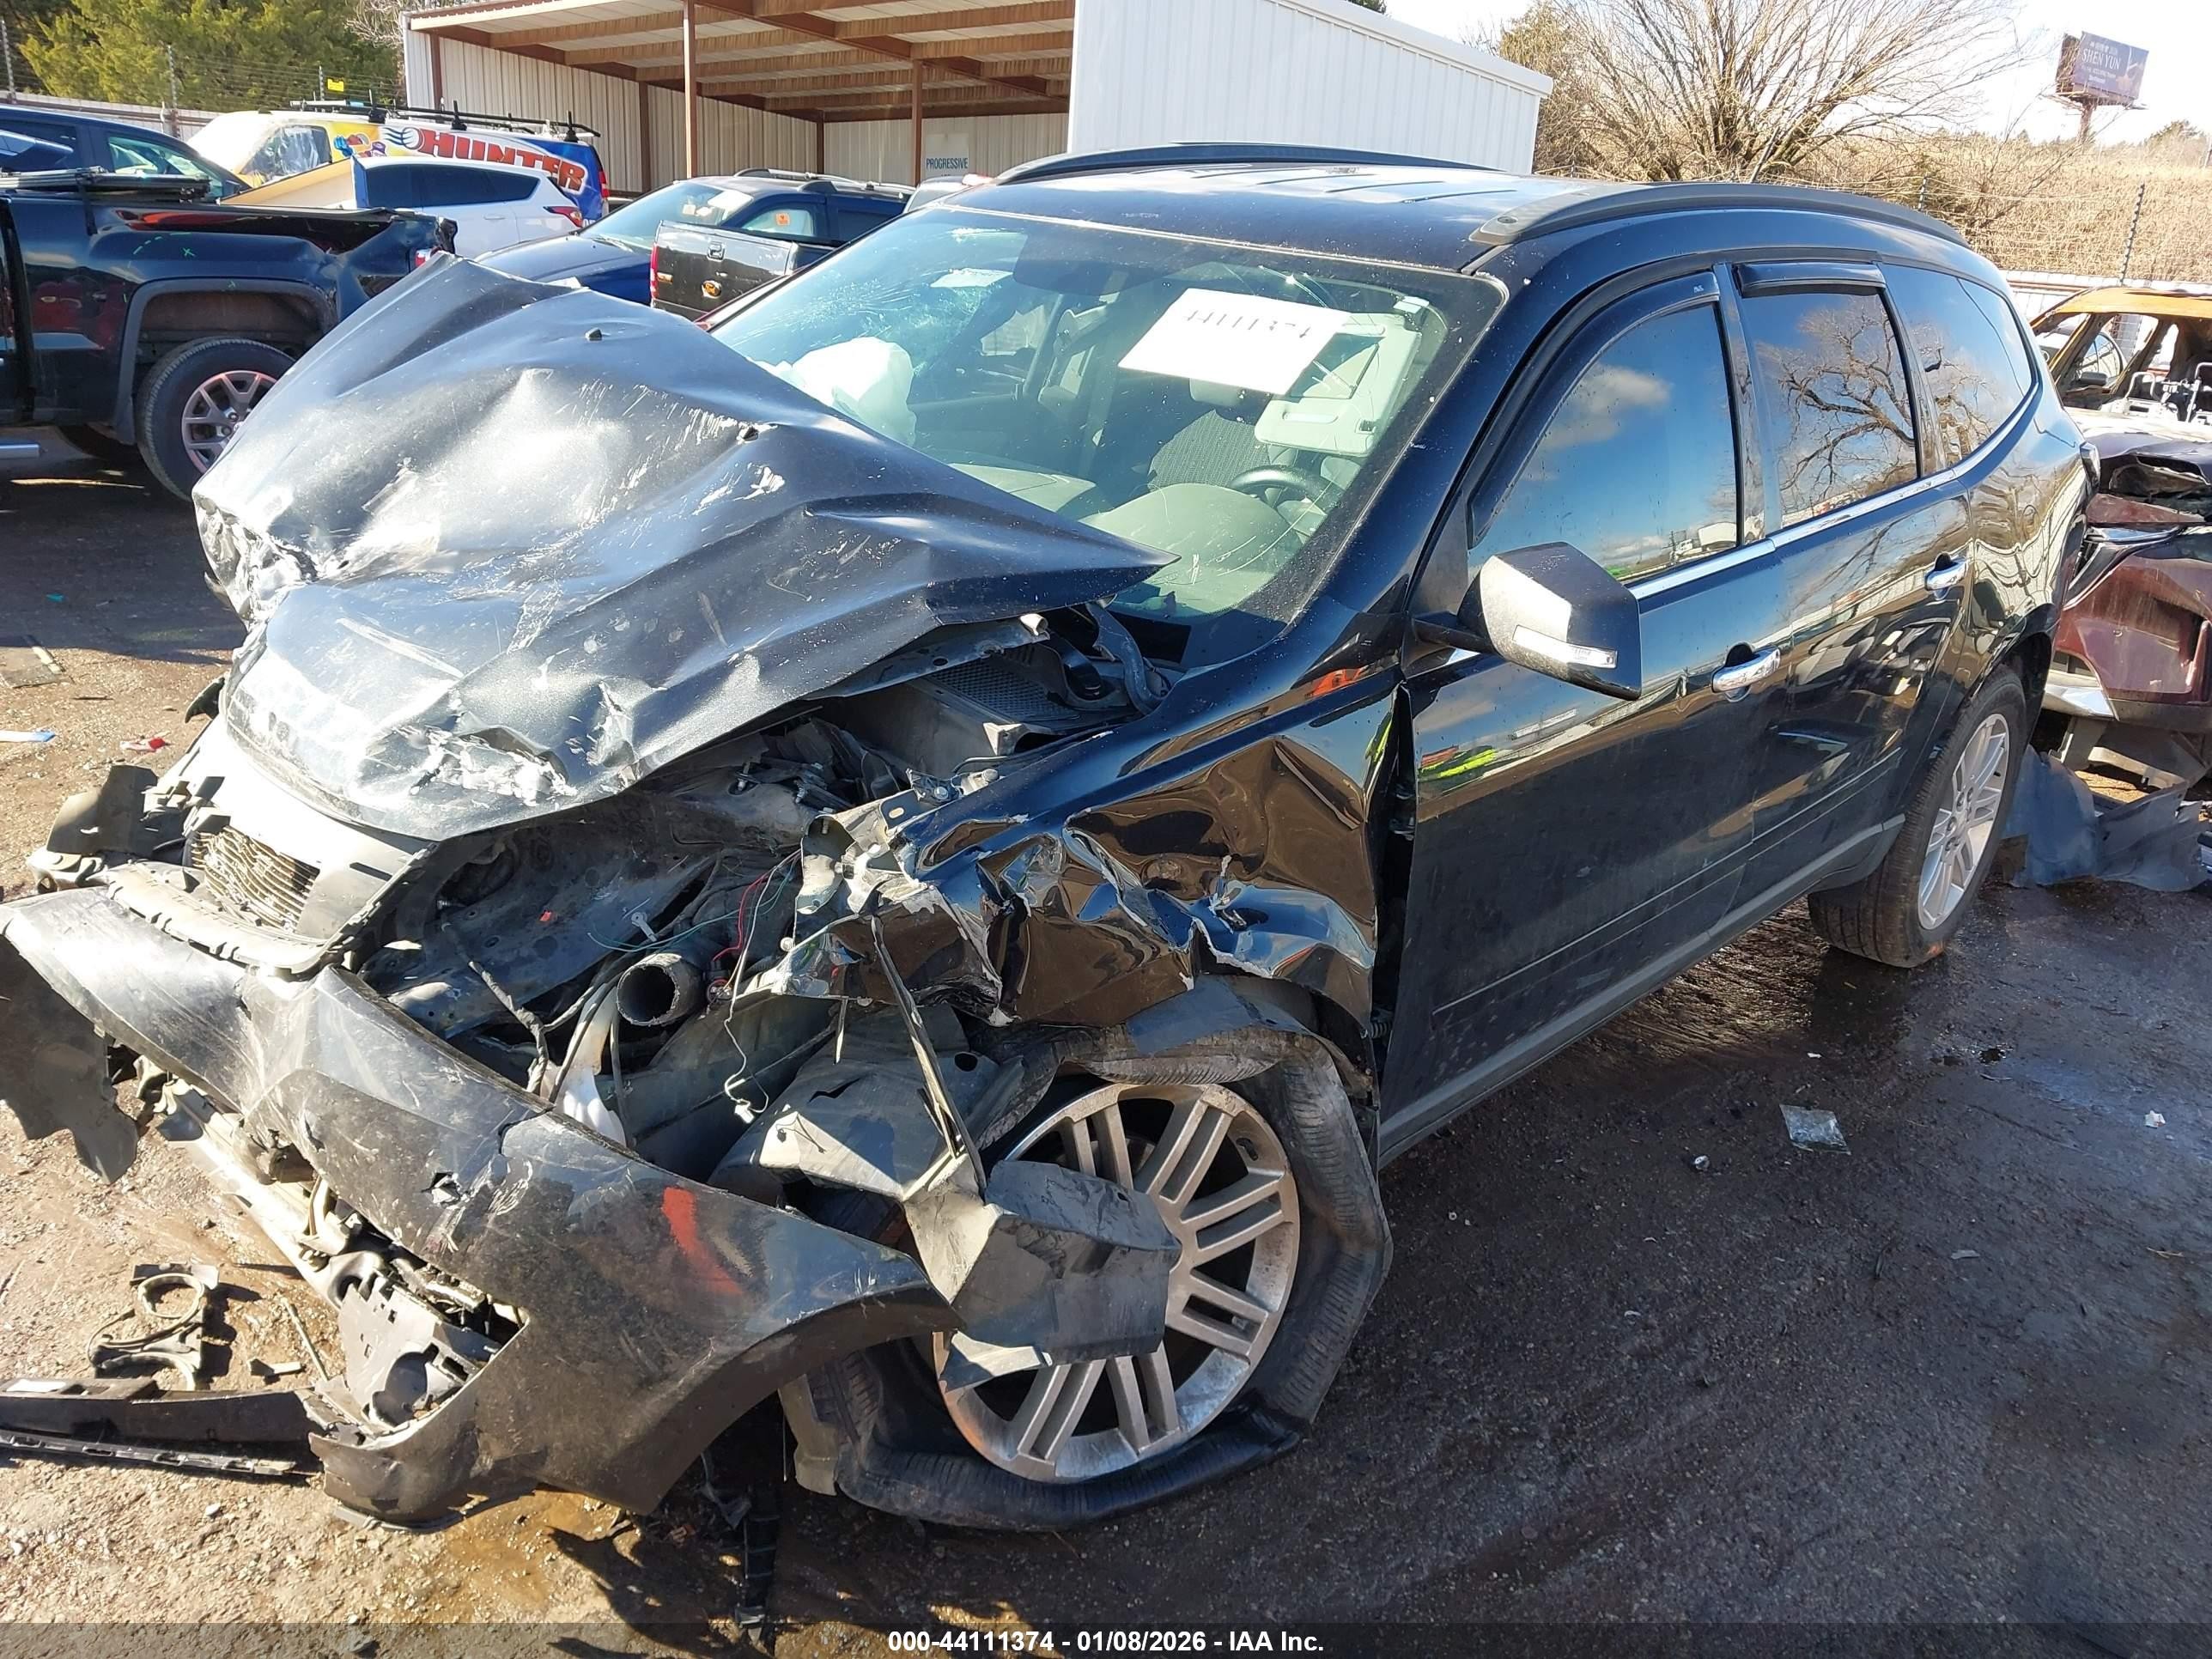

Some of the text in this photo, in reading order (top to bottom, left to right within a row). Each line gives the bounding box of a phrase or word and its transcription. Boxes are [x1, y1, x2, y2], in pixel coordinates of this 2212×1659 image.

[2081, 49, 2122, 70] SHEN YUN
[417, 129, 586, 191] HUNTER
[926, 157, 969, 169] PROGRESSIVE
